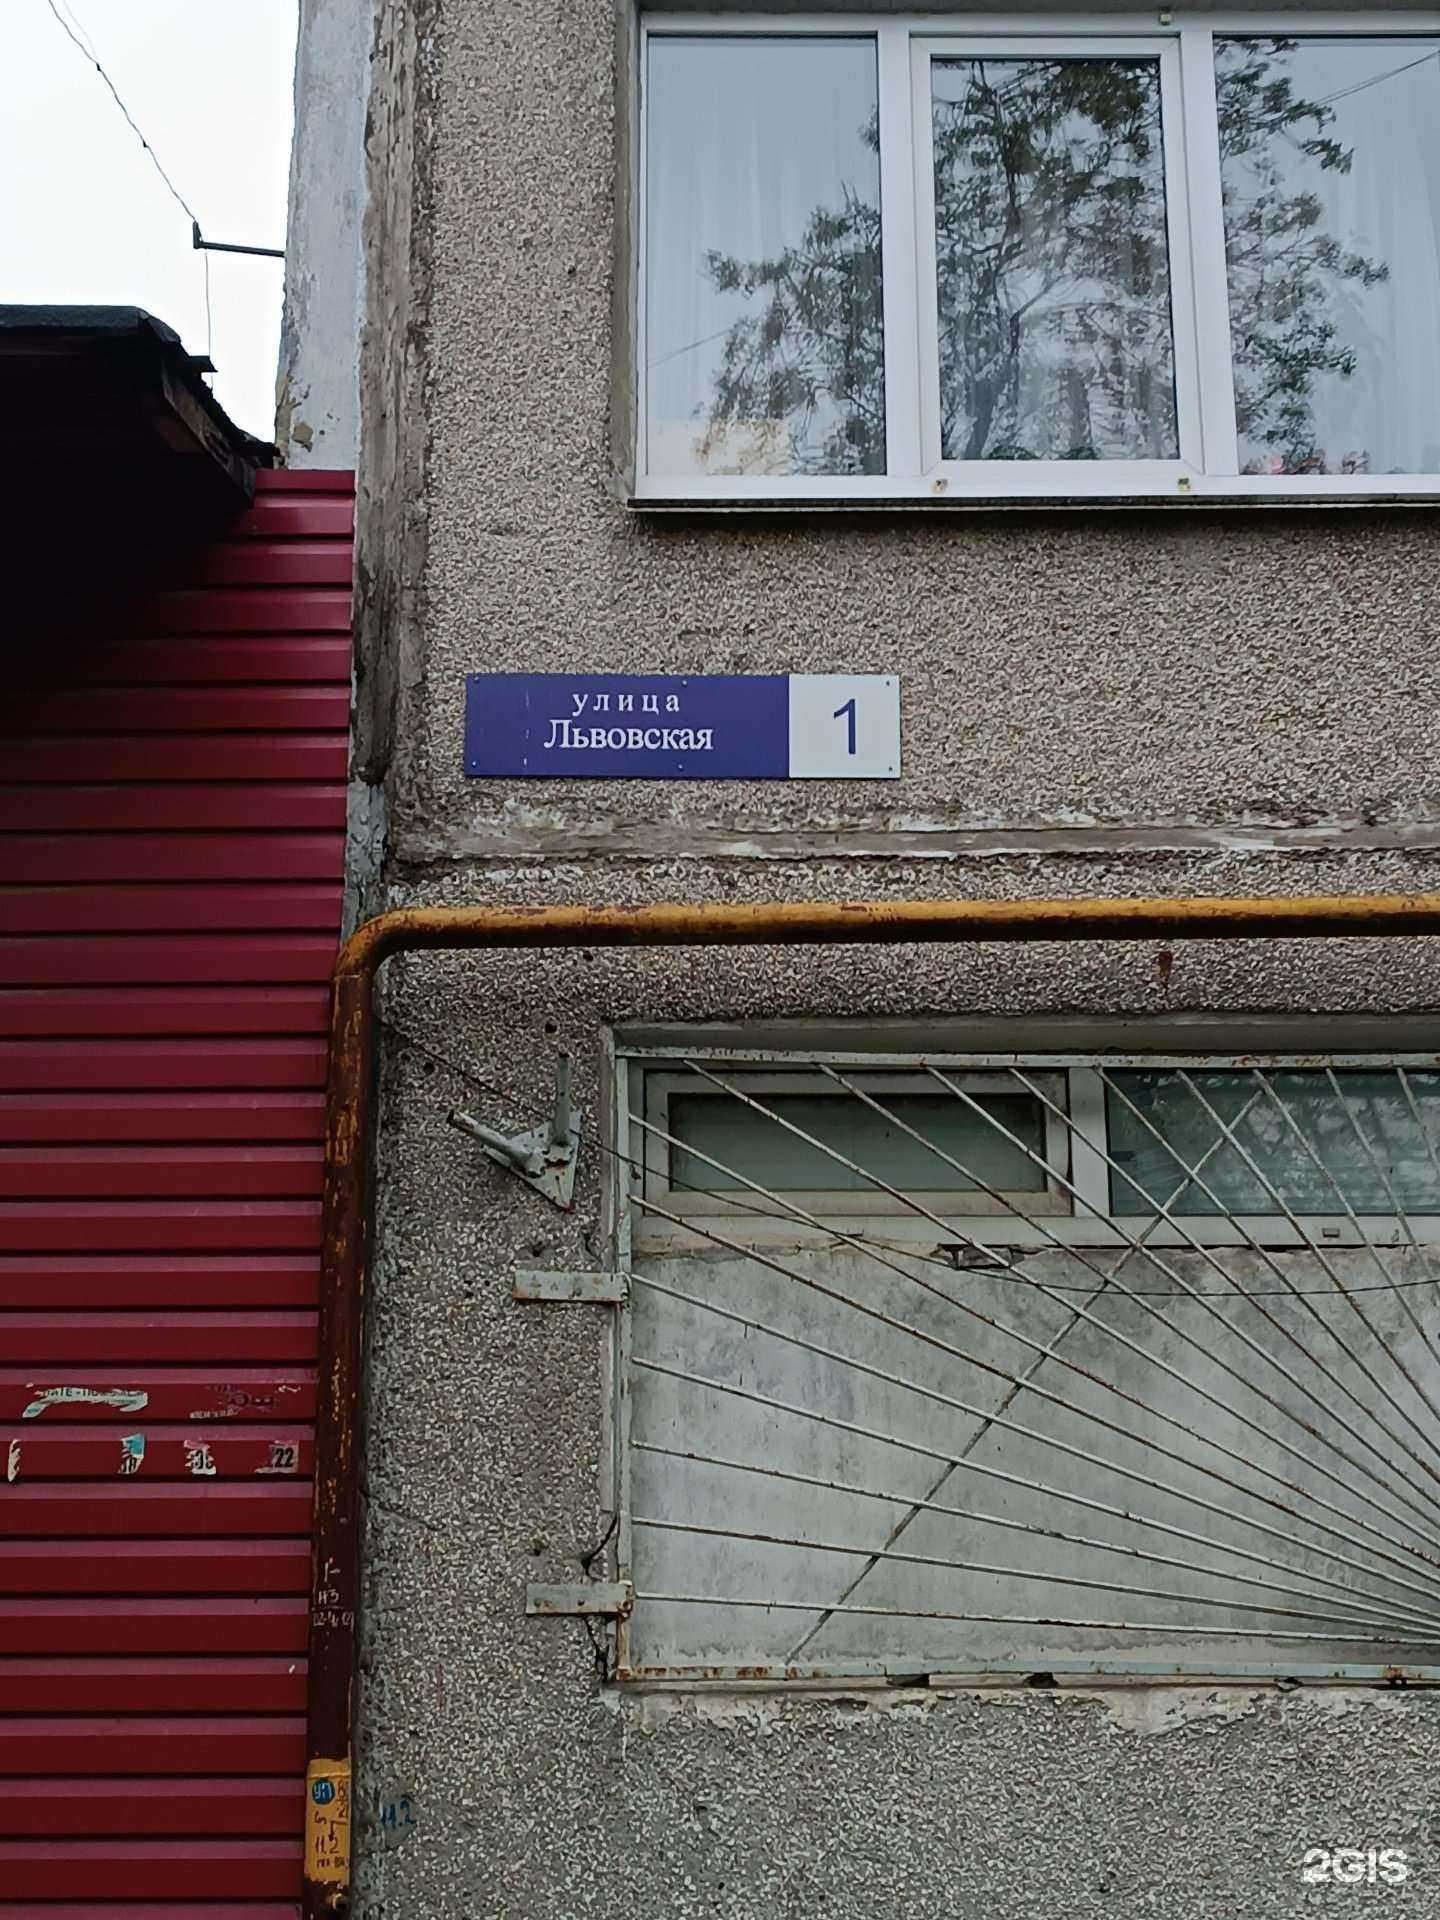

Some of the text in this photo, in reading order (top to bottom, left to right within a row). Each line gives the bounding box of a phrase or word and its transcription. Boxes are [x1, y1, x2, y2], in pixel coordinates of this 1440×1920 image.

[573, 692, 680, 717] улица
[544, 719, 714, 750] Львовская
[833, 698, 857, 755] 1
[274, 1447, 294, 1468] 22
